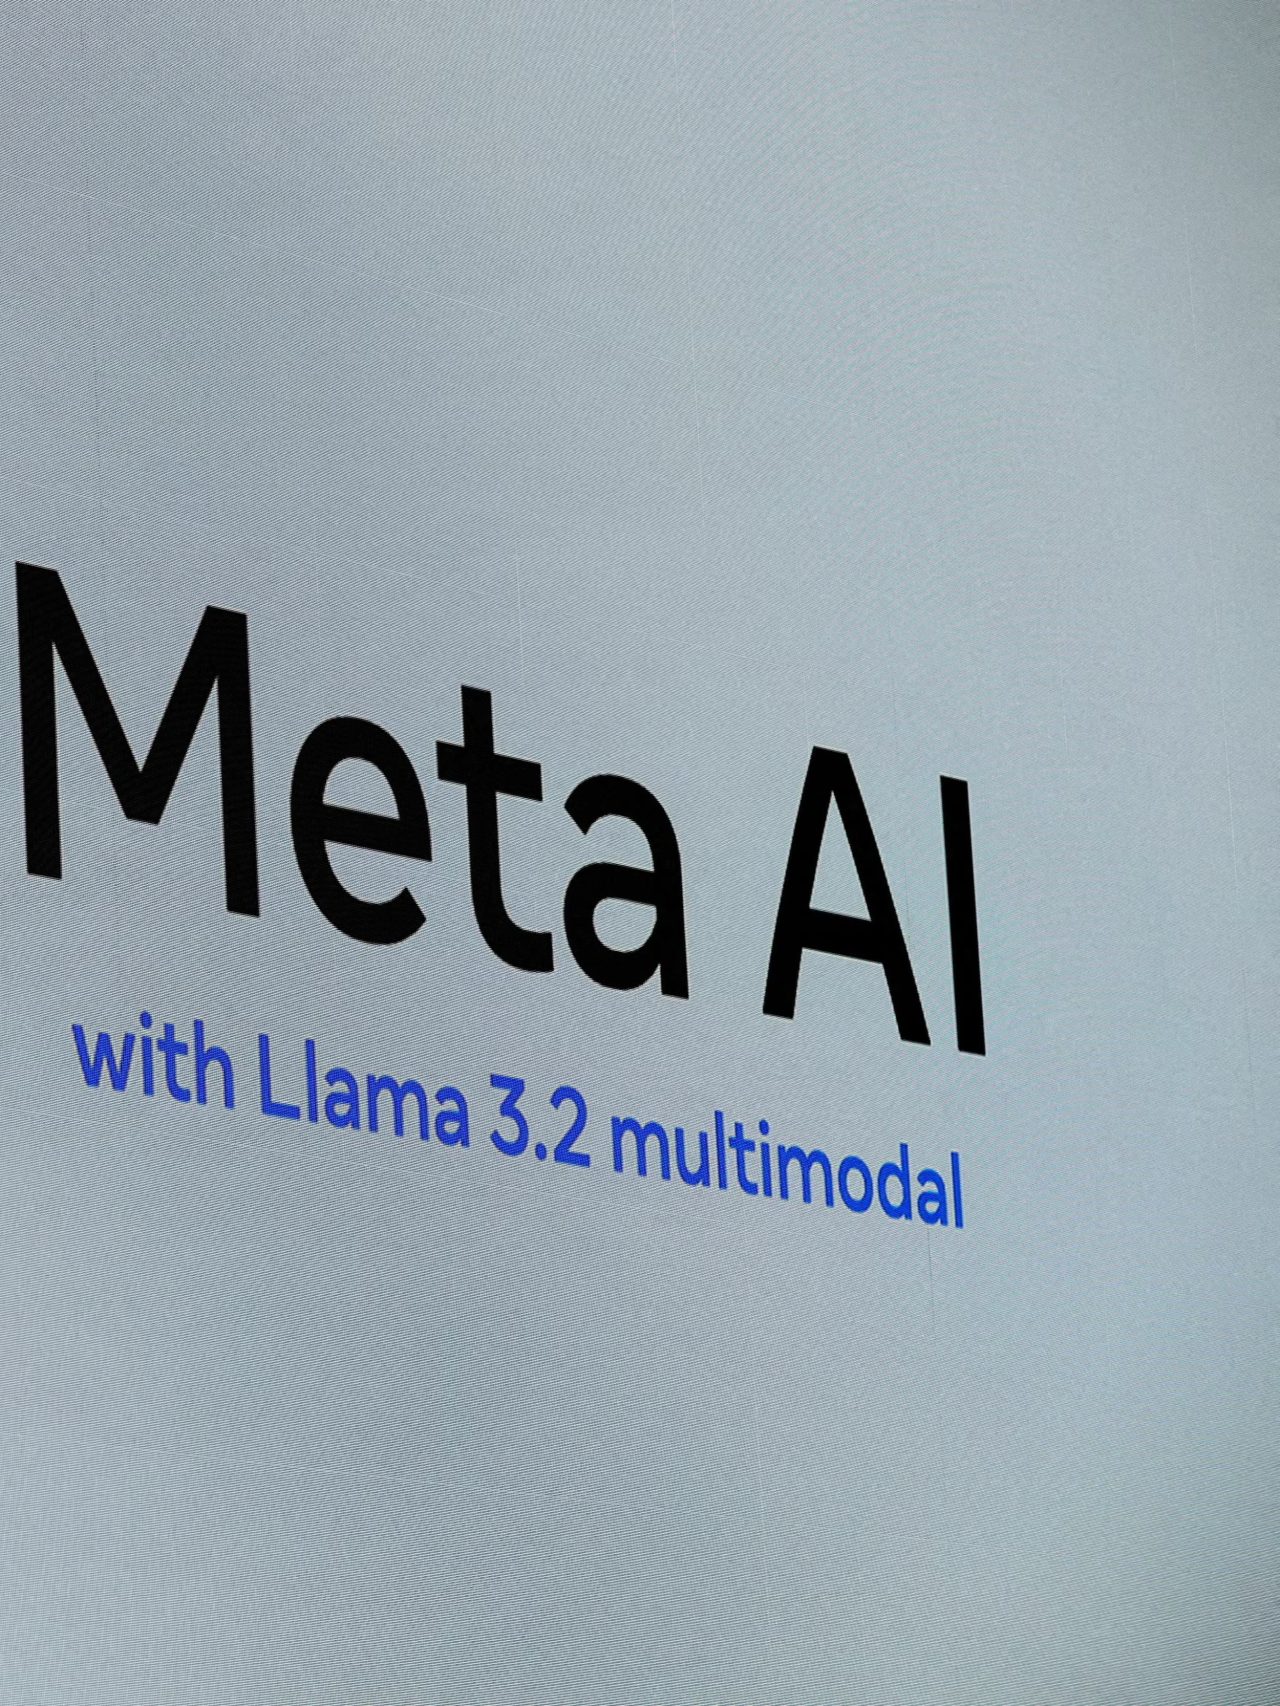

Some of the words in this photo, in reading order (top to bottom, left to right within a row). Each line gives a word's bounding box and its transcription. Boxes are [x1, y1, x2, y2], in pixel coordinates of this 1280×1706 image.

[15, 561, 691, 1000] Meta
[762, 745, 987, 1057] AI
[71, 1010, 237, 1111] with
[259, 1033, 472, 1150] Llama
[489, 1072, 592, 1169] 3.2
[610, 1109, 966, 1230] multimodal
